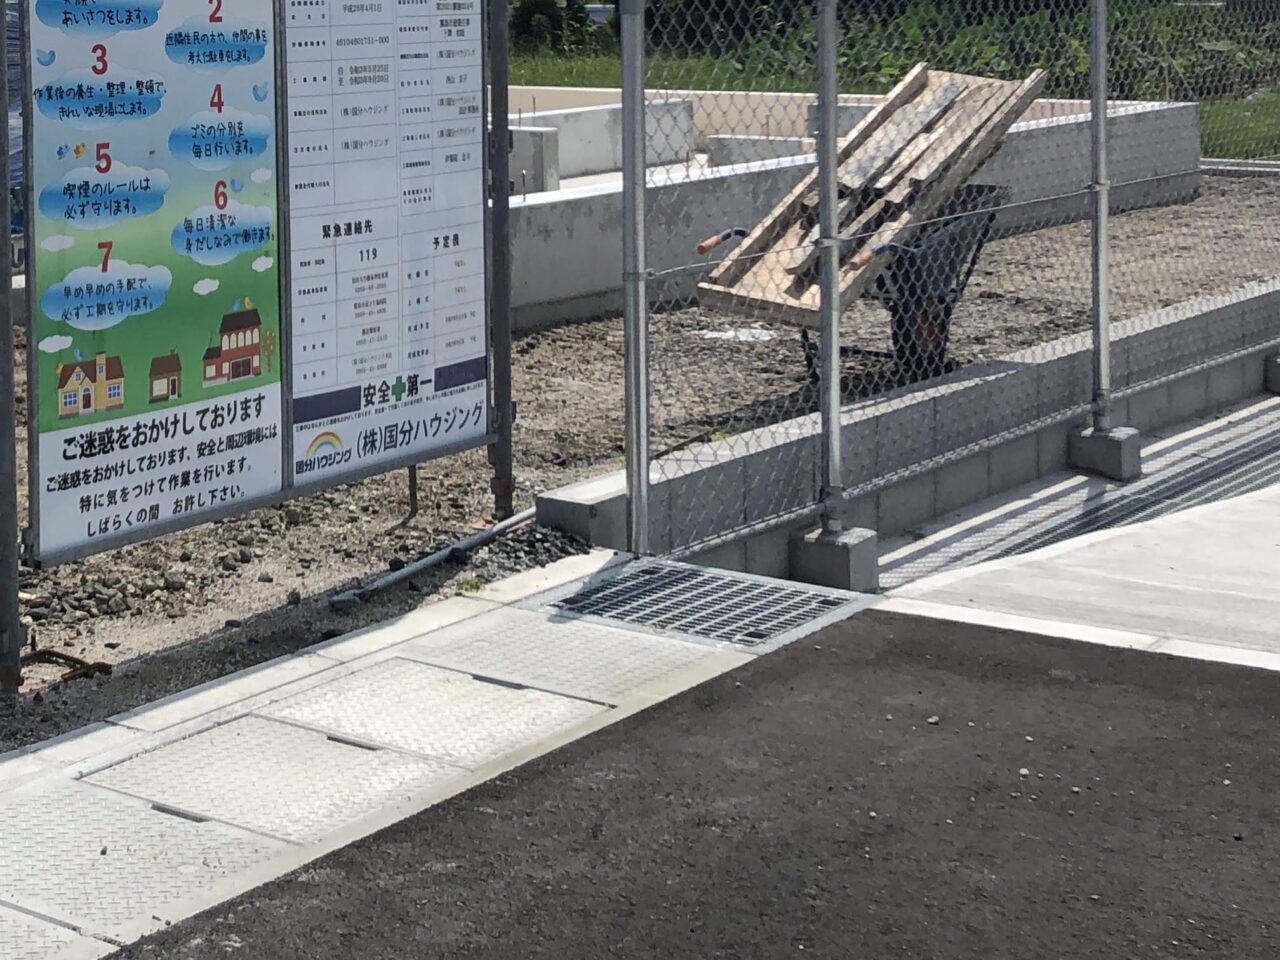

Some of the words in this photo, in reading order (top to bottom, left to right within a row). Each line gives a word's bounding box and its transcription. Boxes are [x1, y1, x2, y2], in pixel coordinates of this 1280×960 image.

[62, 9, 148, 25] あいさつをします。
[91, 44, 108, 75] 3
[209, 84, 224, 113] 4
[95, 143, 111, 172] 5
[62, 178, 151, 200] 喫煙のルールは
[214, 180, 228, 209] 6
[64, 199, 137, 220] 必ず守ります。
[322, 220, 373, 240] 緊急連絡先
[97, 242, 113, 273] 7
[359, 248, 377, 262] 119
[363, 380, 391, 407] 安全
[407, 373, 433, 397] 第一
[62, 393, 266, 462] ご迷惑をおかけしております
[357, 402, 484, 460] (株)国分ハウジング
[46, 423, 277, 492] ご迷惑をおかけしております、安全と周辺環境には
[296, 447, 351, 475] 国分ハウジング
[79, 455, 251, 514] 特に気をつけて作業を行います。
[87, 504, 159, 537] しばらくの間
